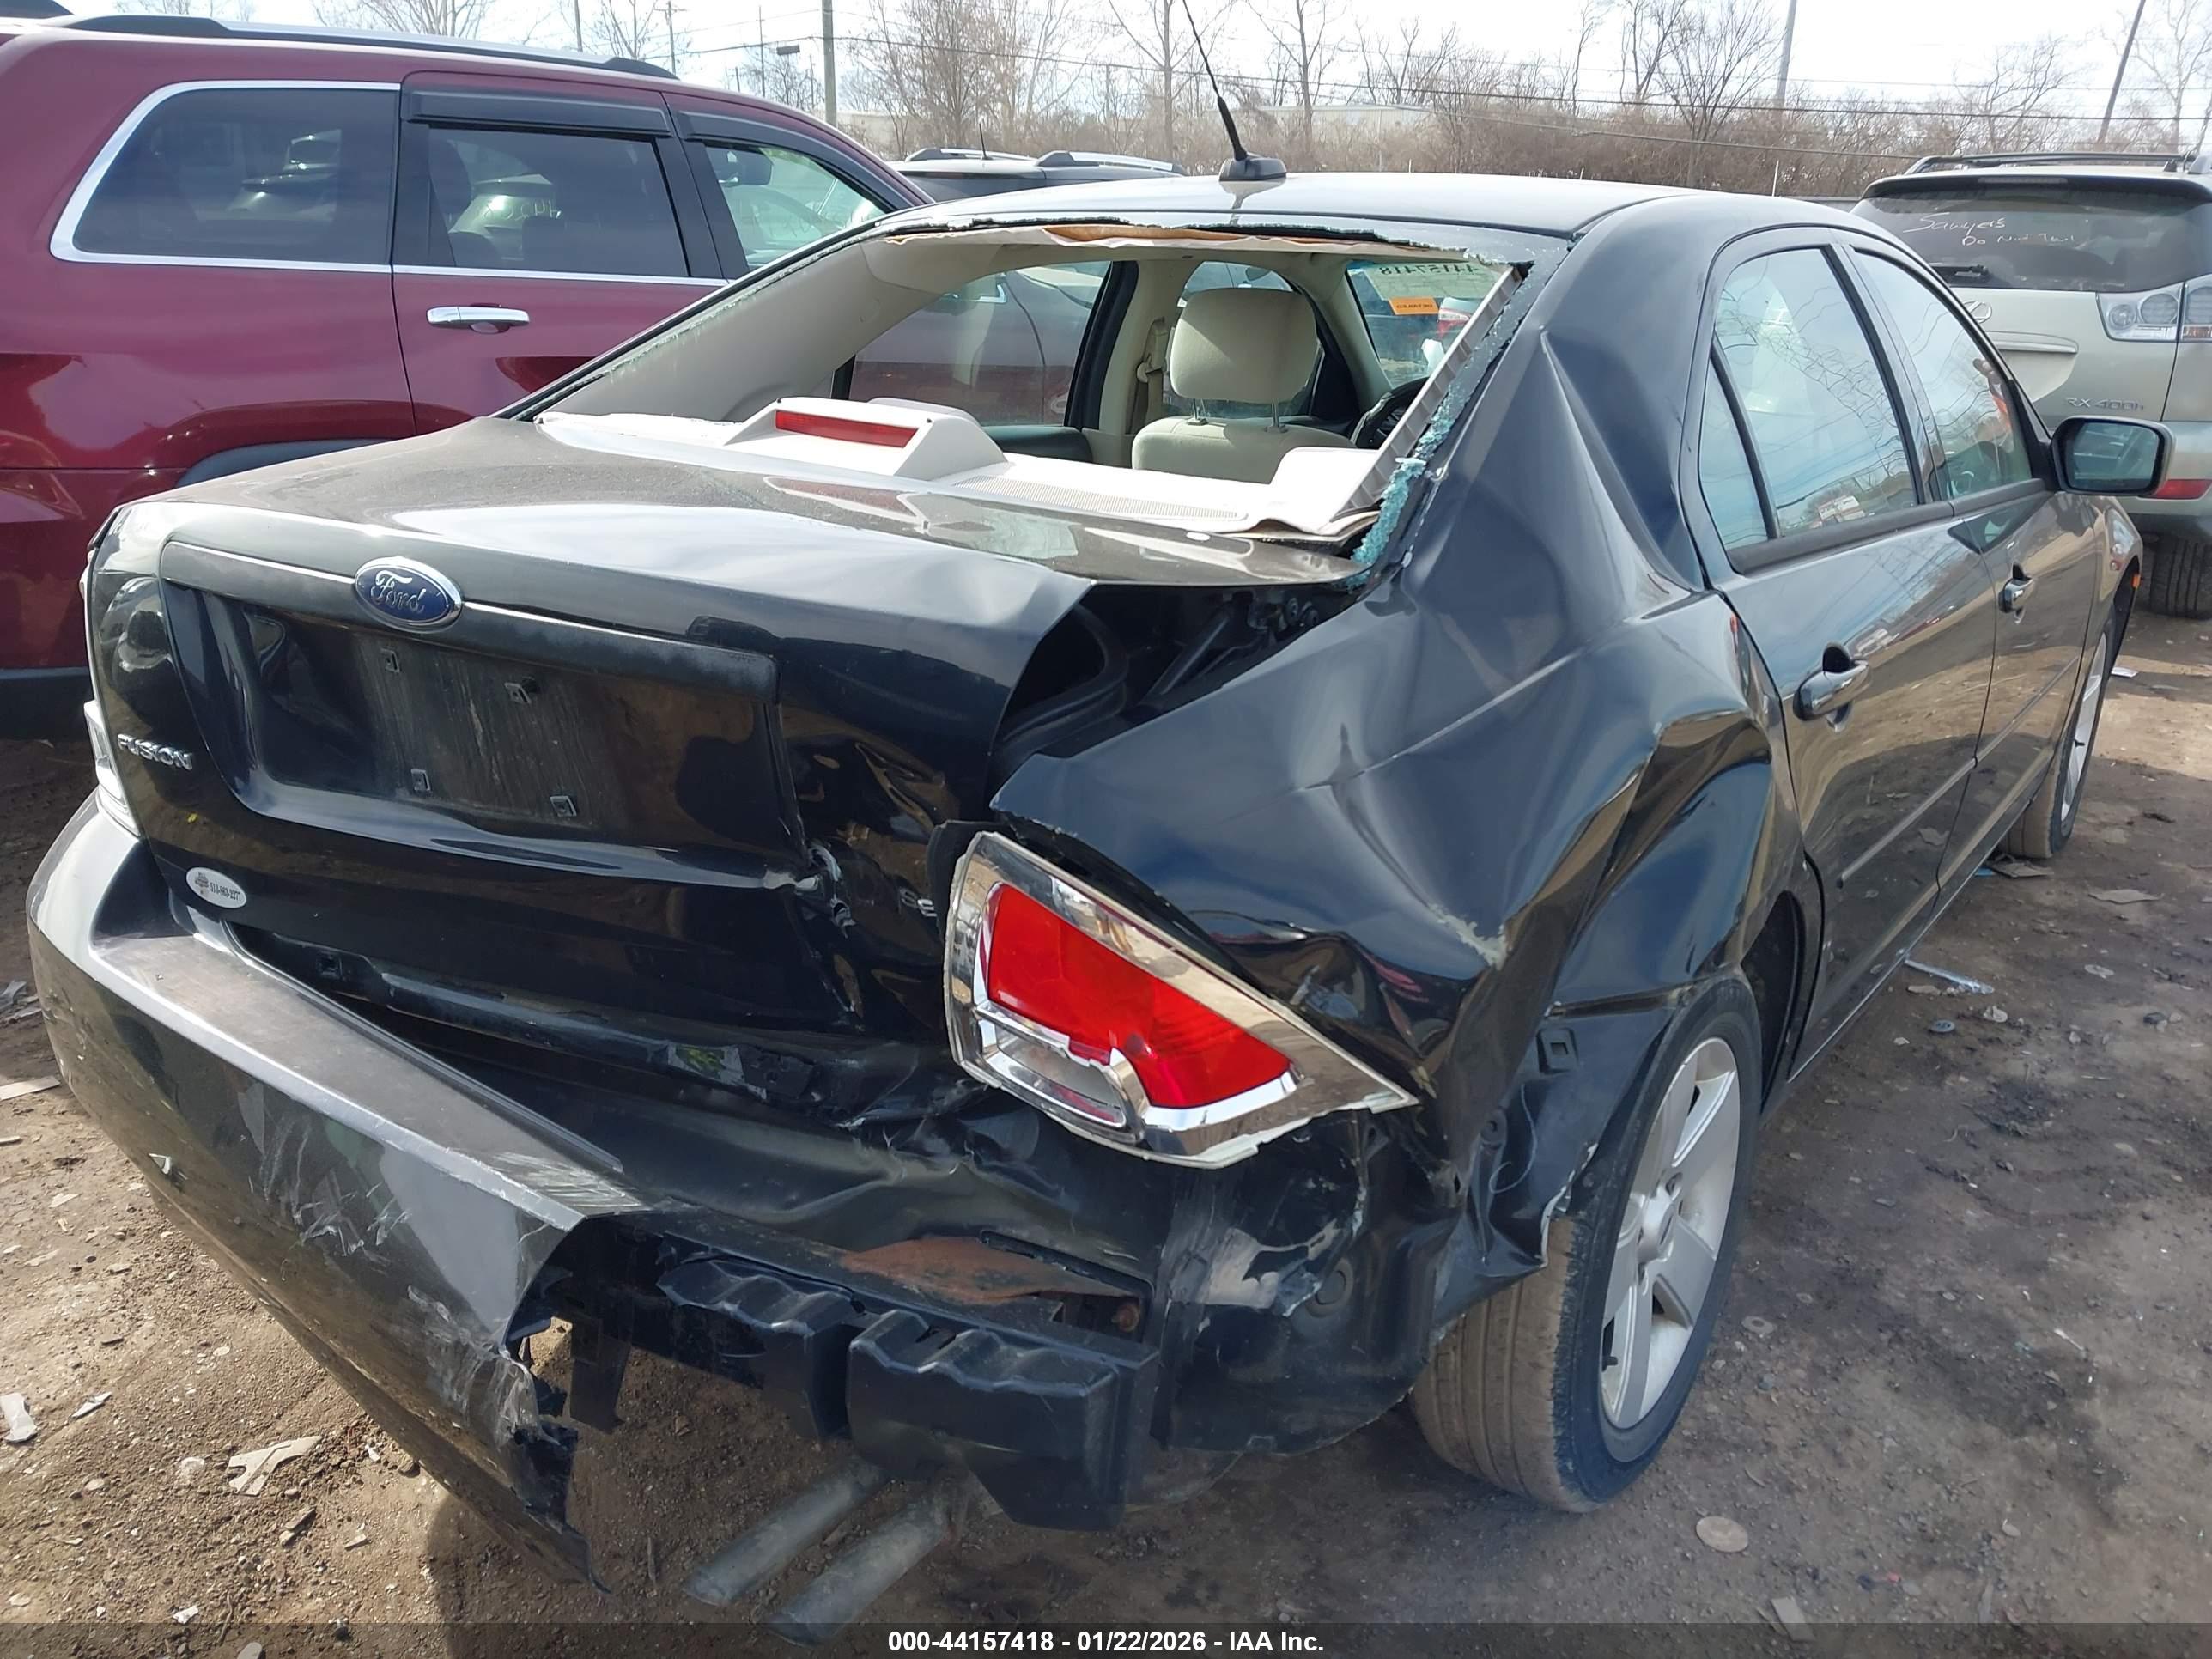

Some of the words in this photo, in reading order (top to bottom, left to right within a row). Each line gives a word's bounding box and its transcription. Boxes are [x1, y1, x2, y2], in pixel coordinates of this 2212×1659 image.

[1961, 235, 1986, 246] Do
[2066, 398, 2091, 408] RX
[370, 569, 428, 614] Ford
[117, 733, 193, 771] FUSION
